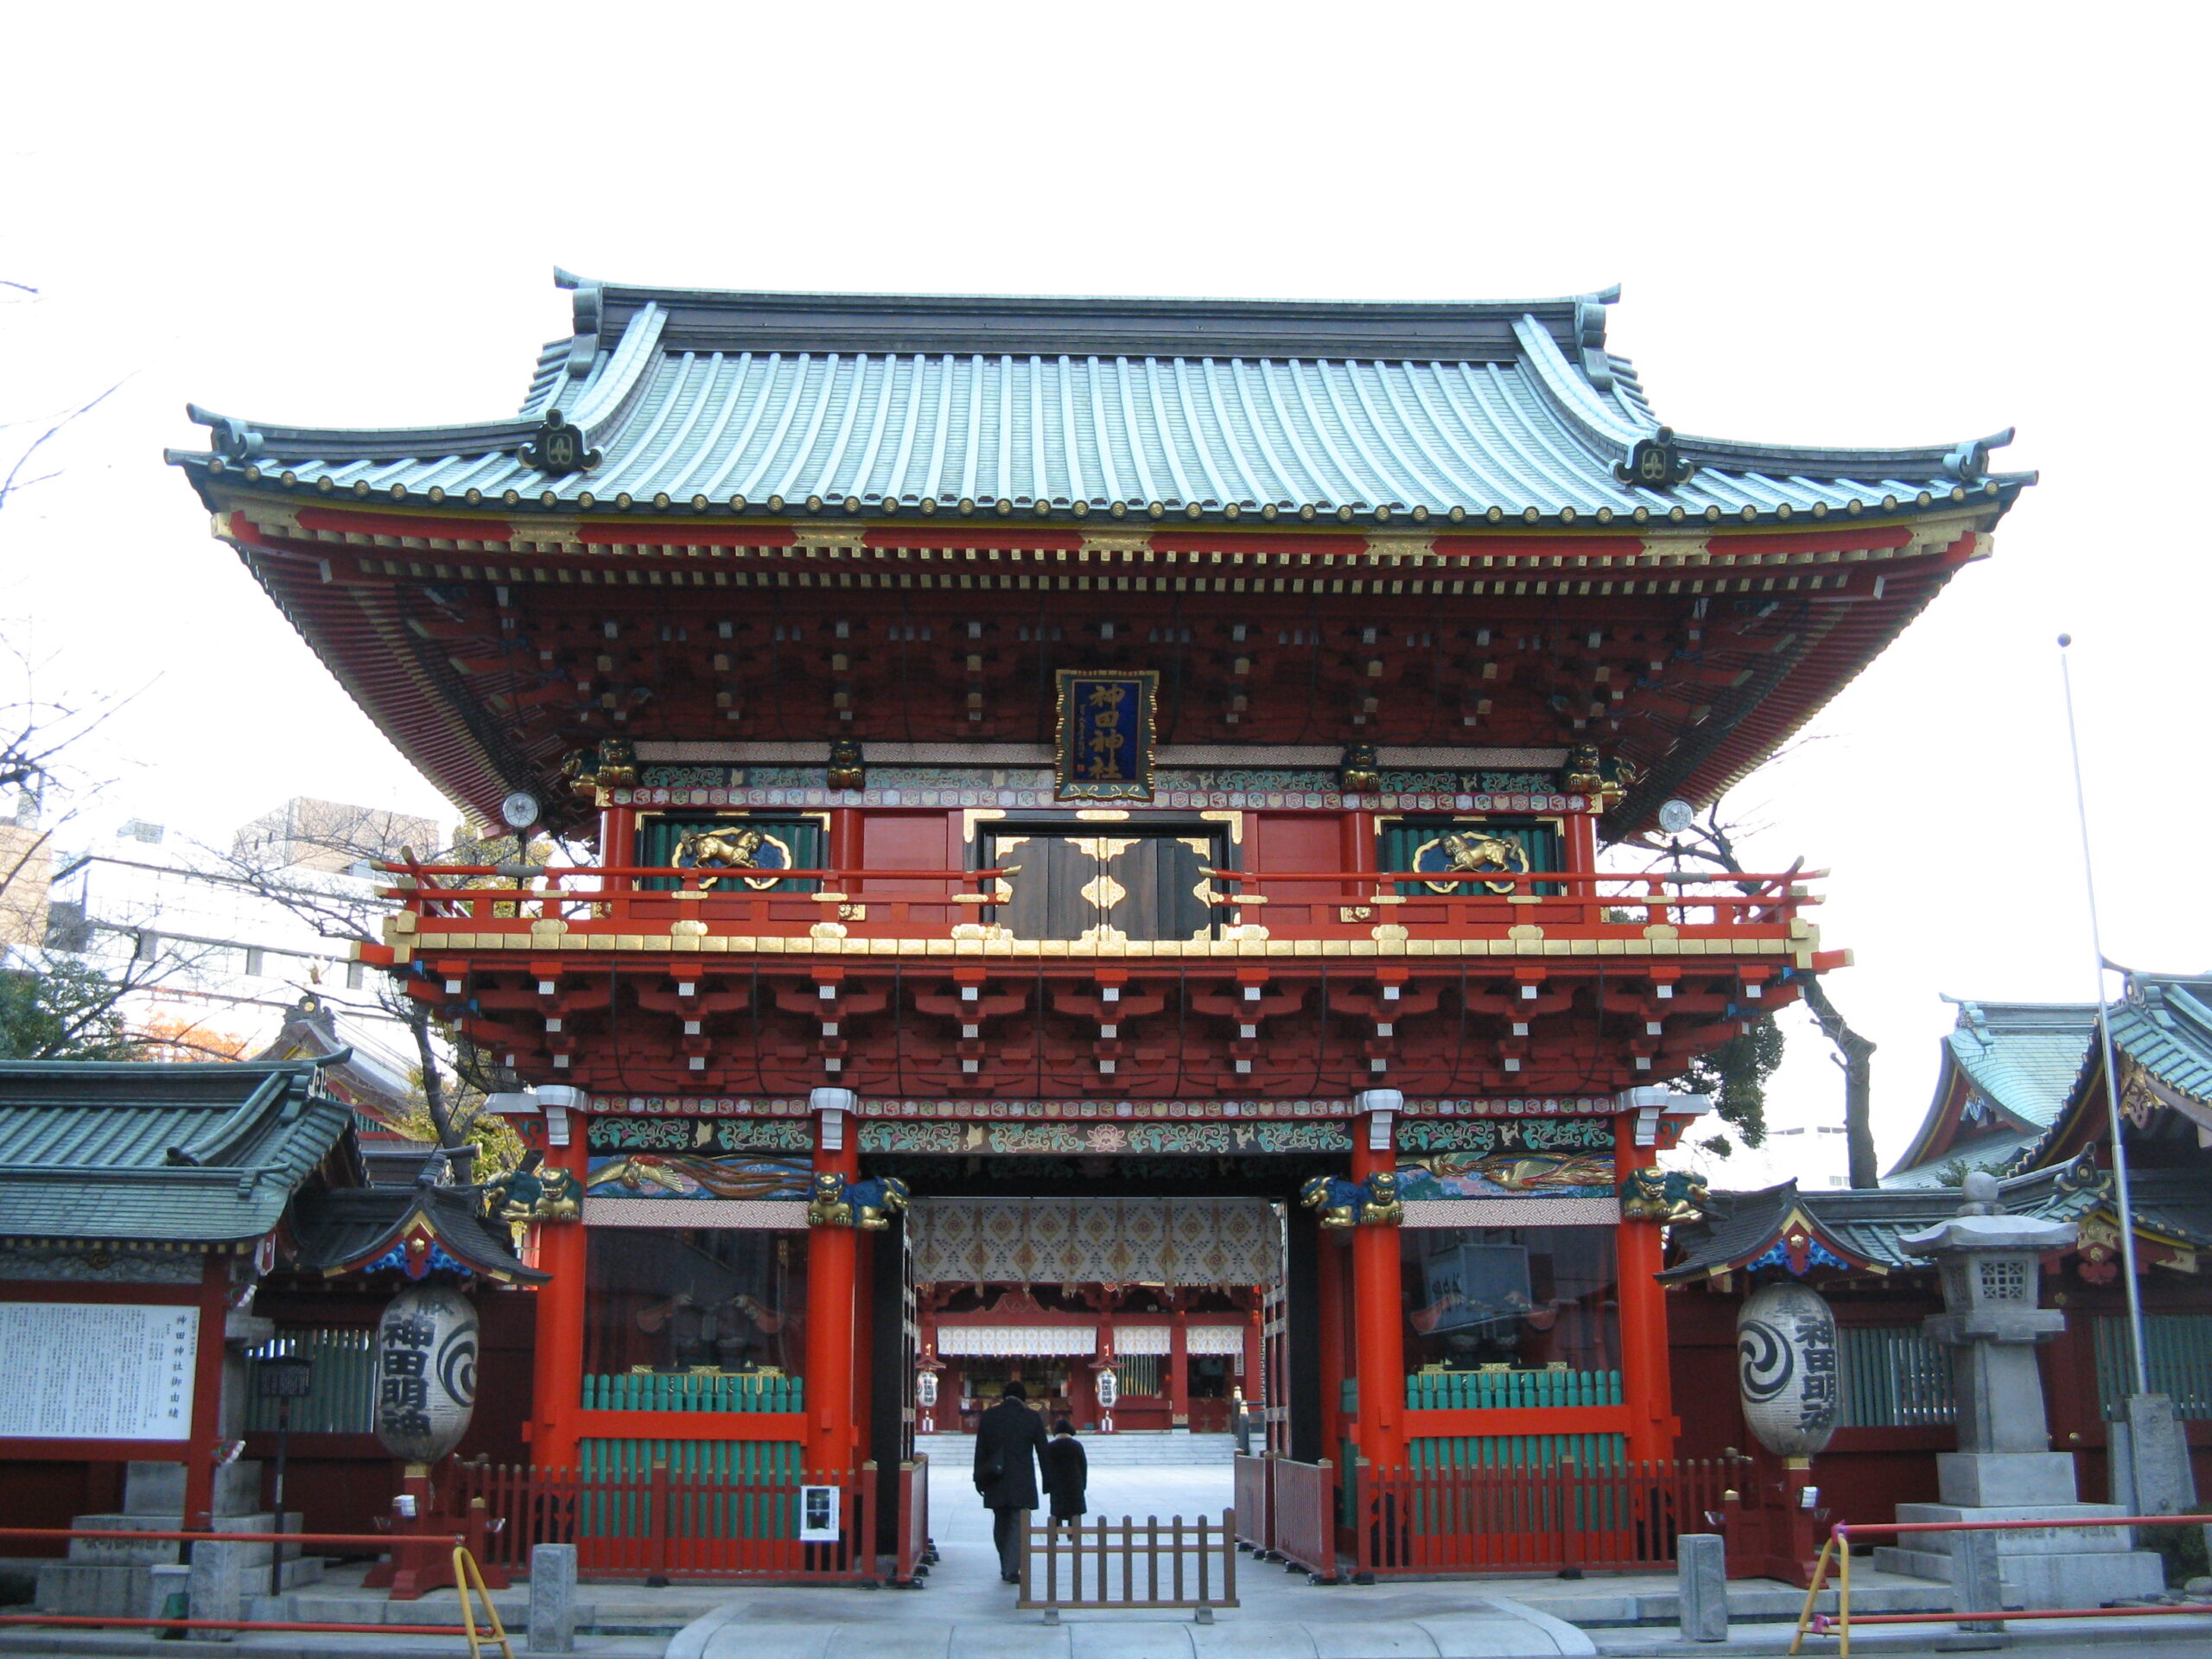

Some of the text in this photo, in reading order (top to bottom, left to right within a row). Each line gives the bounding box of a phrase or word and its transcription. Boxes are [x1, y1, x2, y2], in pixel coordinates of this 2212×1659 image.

[1089, 683, 1126, 780] 神田神社
[382, 1313, 435, 1436] 神田明神
[1795, 1315, 1836, 1434] 神田明神
